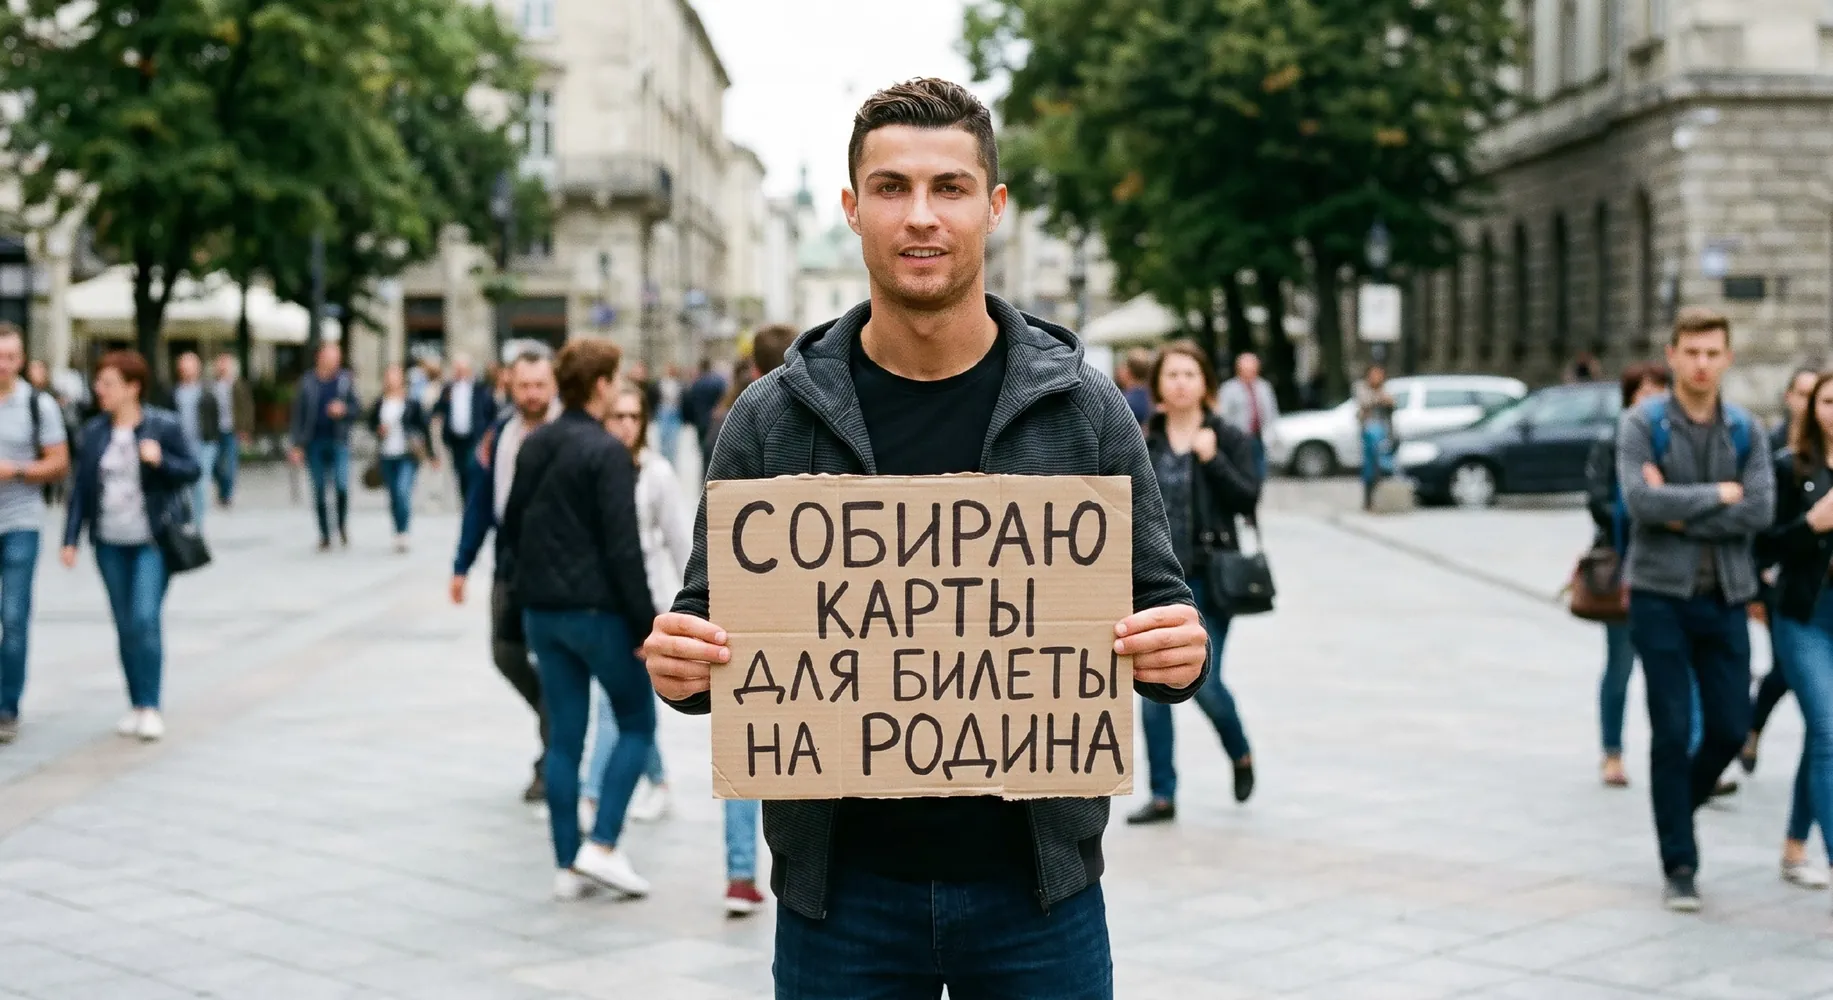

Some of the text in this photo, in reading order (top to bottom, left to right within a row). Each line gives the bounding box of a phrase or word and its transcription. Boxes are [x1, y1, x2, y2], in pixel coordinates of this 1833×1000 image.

[732, 500, 1106, 573] СОБИРАЮ
[818, 578, 1034, 639] КАРТЫ
[733, 647, 1118, 705] ДЛЯ БИЛЕТЫ
[748, 711, 1124, 780] НА РОДИНА
